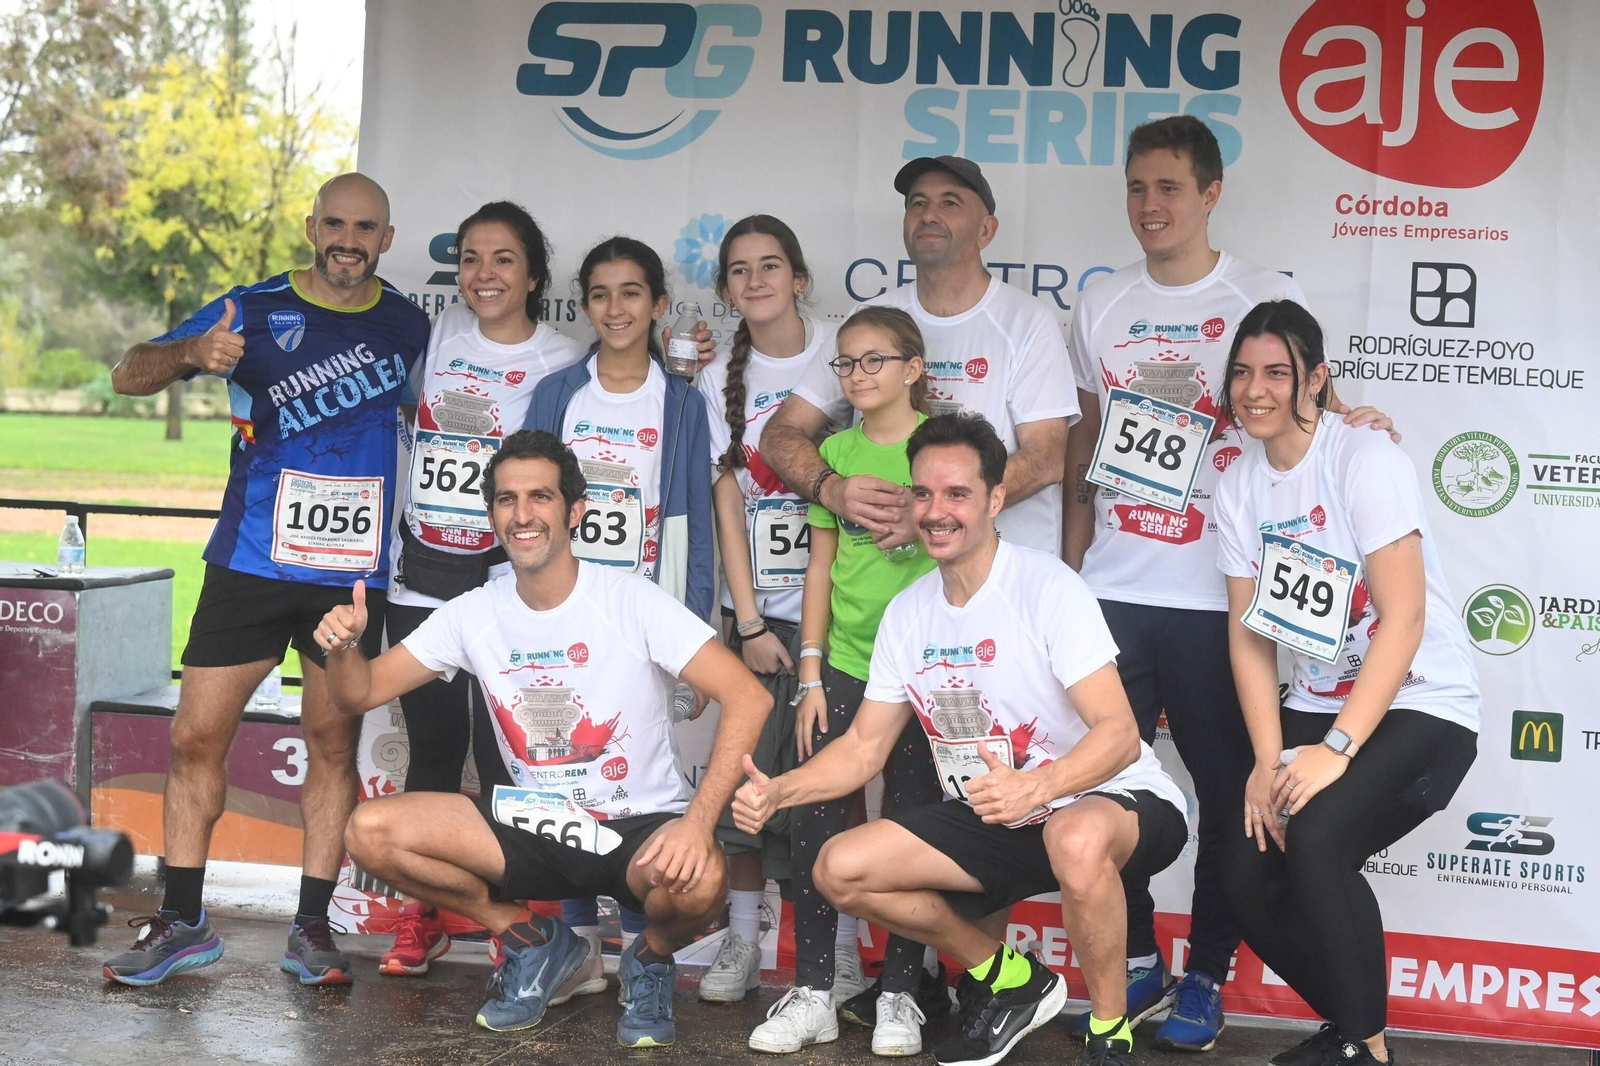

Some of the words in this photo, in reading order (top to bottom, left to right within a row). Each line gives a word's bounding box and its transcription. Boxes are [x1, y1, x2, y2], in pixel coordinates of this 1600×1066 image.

[516, 1, 762, 98] SPG
[1296, 0, 1519, 148] aje
[1335, 193, 1449, 217] Córdoba
[1332, 222, 1398, 239] Jóvenes
[1403, 224, 1509, 241] Empresarios
[1202, 321, 1223, 336] aje
[1349, 334, 1535, 361] RODRÍGUEZ-POYO
[267, 342, 376, 407] RUNNING
[966, 362, 987, 375] aje
[1329, 358, 1418, 381] DRÍGUEZ
[1422, 364, 1450, 383] DE
[1453, 365, 1585, 390] TEMBLEQUE
[278, 353, 407, 439] ALCOLEA
[637, 430, 656, 443] aje
[1114, 418, 1187, 471] 548
[420, 456, 480, 495] 562
[286, 501, 371, 535] 1056
[580, 508, 627, 546] 63
[1139, 521, 1183, 539] SERIES
[441, 532, 480, 546] SERIES
[1269, 562, 1334, 617] 549
[0, 599, 64, 624] DECO
[568, 646, 588, 661] aje
[976, 643, 994, 659] aje
[270, 737, 308, 785] 3
[531, 768, 587, 779] ENTROREM
[602, 761, 626, 779] aje
[1364, 861, 1418, 877] BLEQUE
[1426, 852, 1511, 877] SUPERATE
[1520, 861, 1586, 883] SPORTS
[1437, 874, 1518, 890] ENTRENAMIENTO
[1521, 882, 1573, 894] PERSONAL
